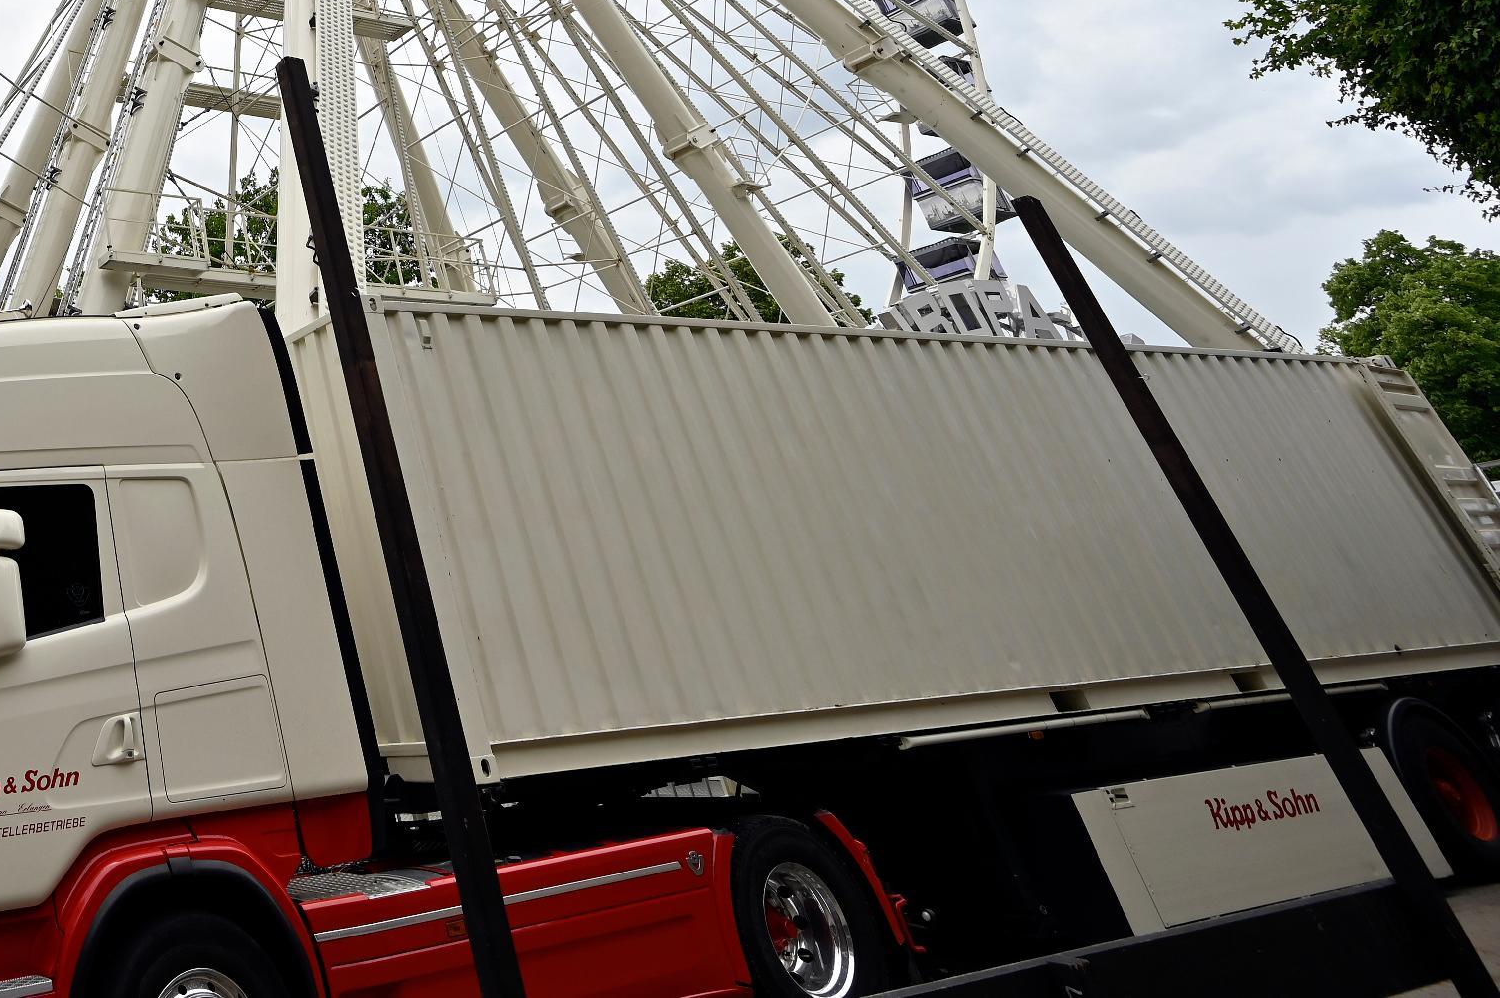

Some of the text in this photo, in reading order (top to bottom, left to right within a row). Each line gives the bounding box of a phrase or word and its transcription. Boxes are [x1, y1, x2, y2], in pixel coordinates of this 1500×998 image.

[3, 776, 17, 795] &
[21, 768, 80, 793] Sohn
[1205, 788, 1320, 831] Kipp & Sohn
